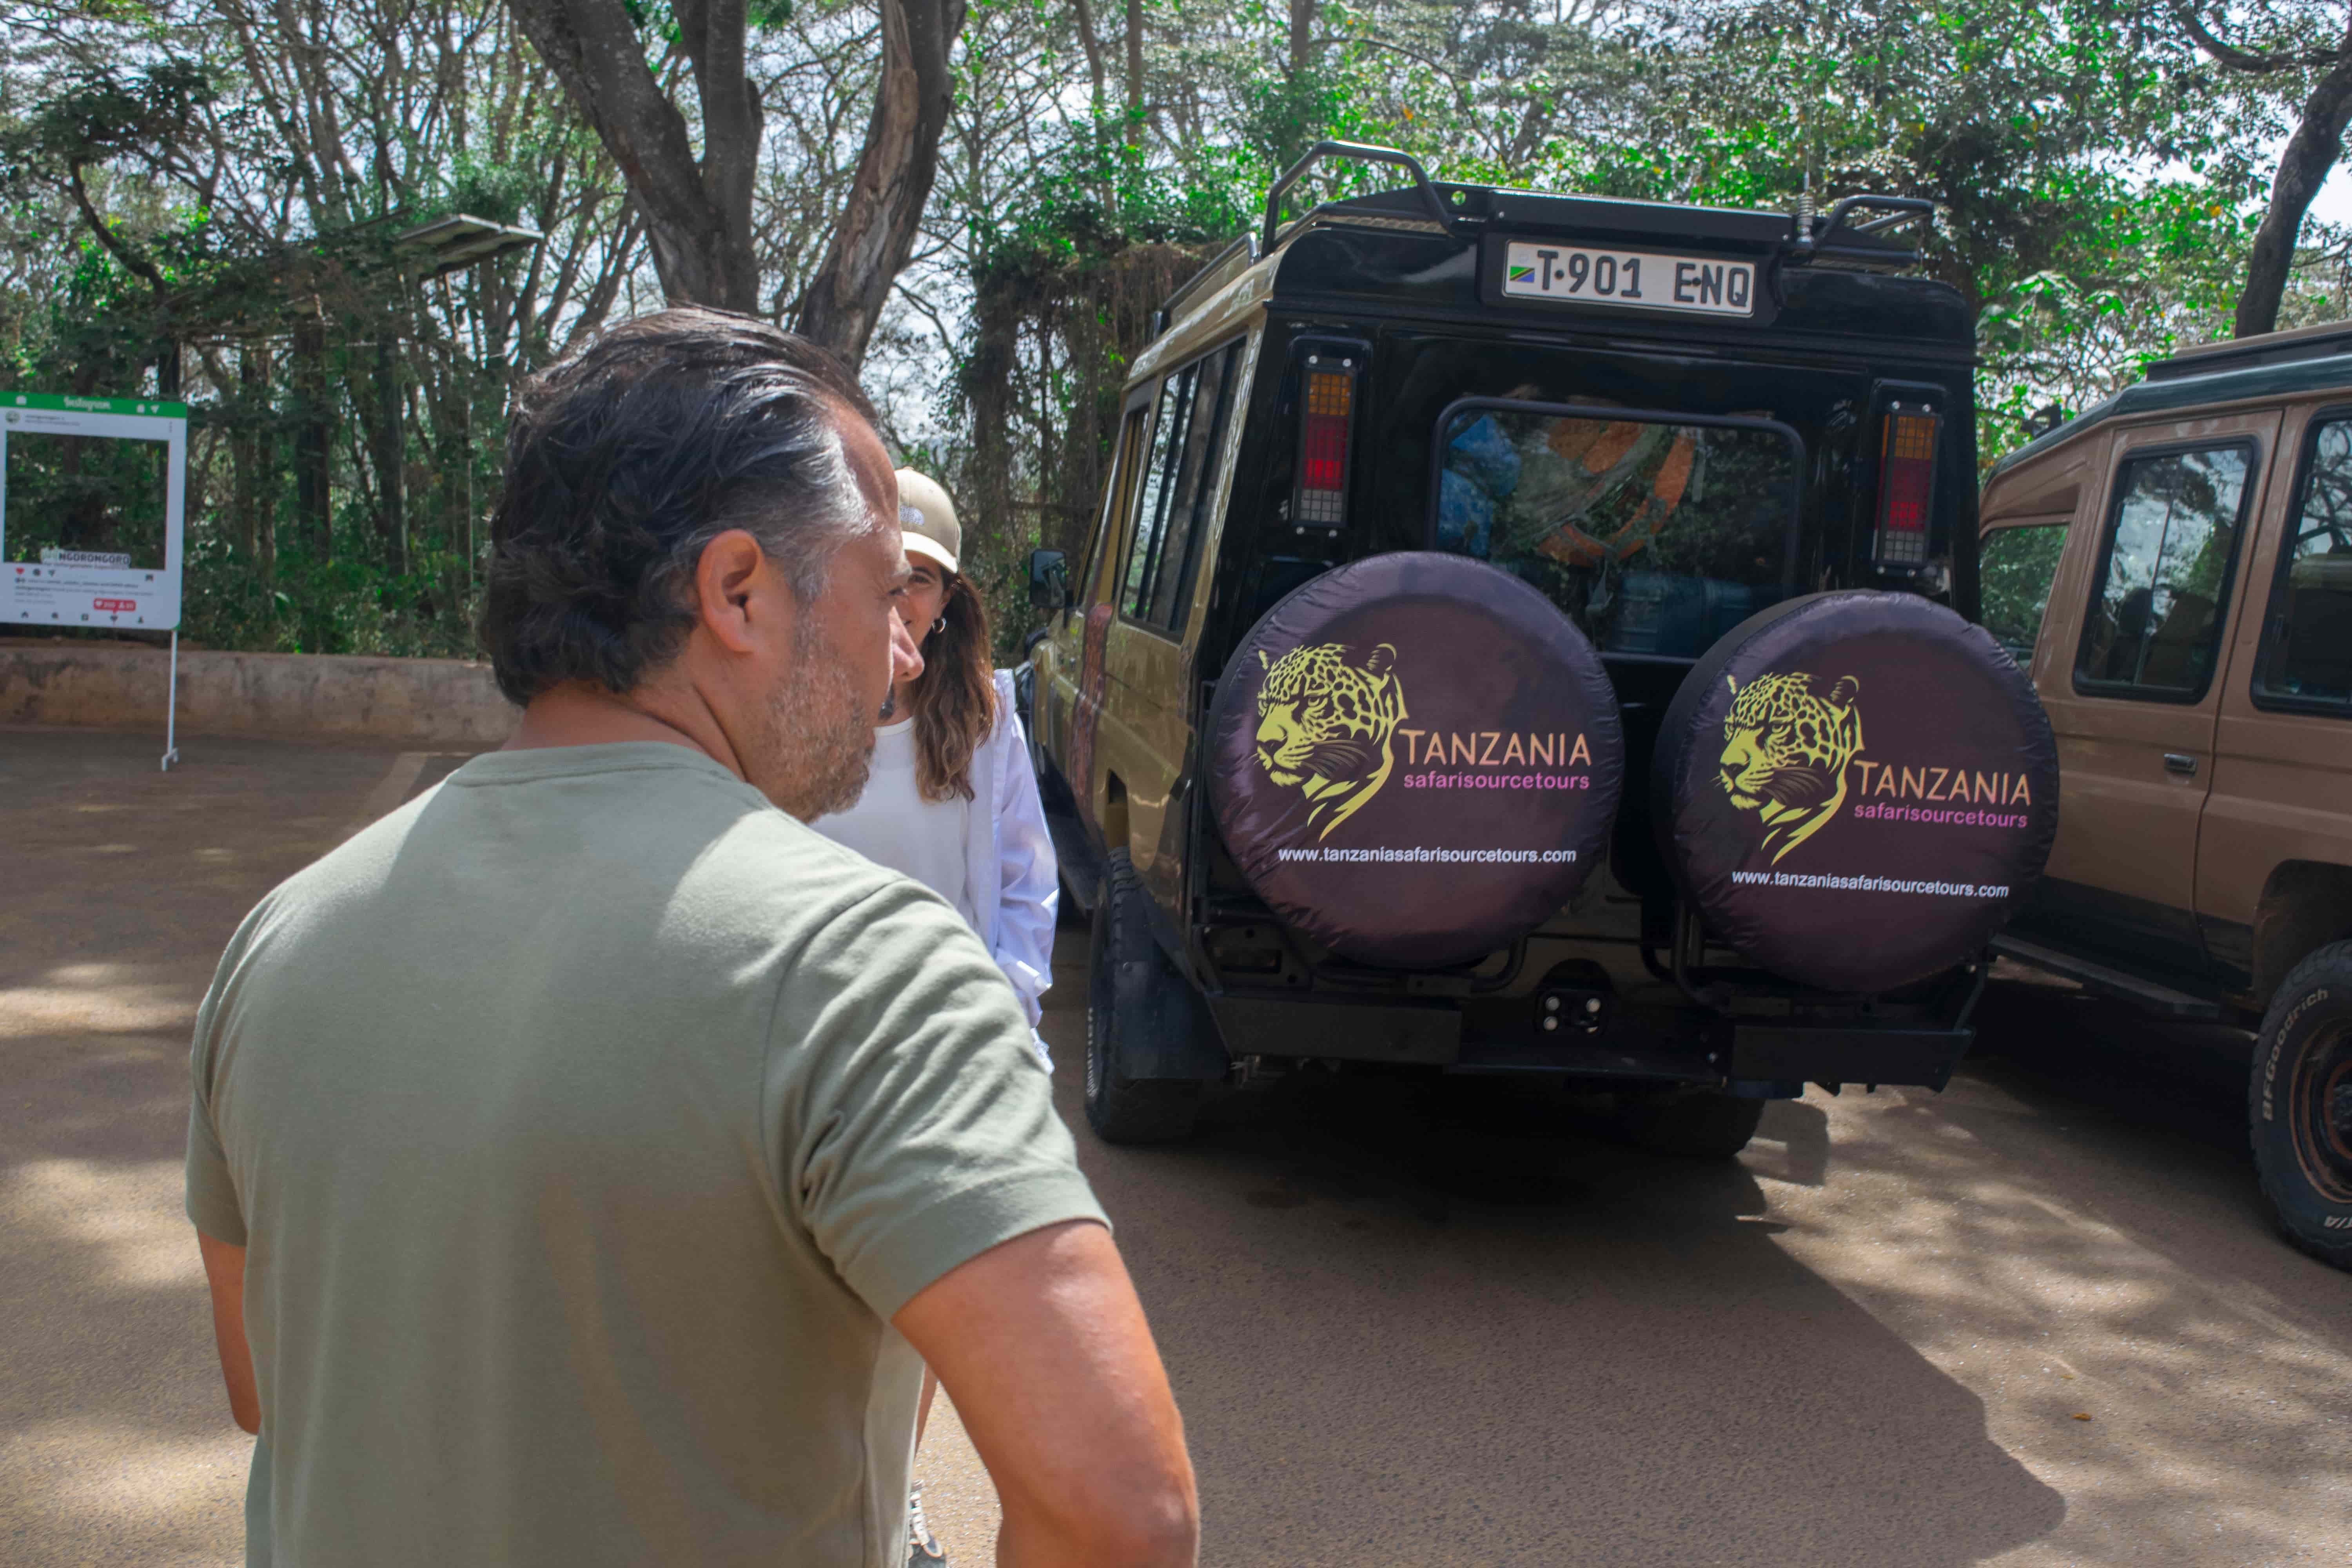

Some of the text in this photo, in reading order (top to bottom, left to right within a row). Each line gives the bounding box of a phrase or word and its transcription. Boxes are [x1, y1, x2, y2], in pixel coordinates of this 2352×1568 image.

[1674, 262, 1749, 307] ENQ
[59, 553, 130, 564] NGORONGORO
[1398, 728, 1592, 766] TANZANIA
[1403, 771, 1590, 789] safarisourcetours
[1854, 760, 2031, 806] TANZANIA
[1854, 802, 2028, 828] safarisourcetours
[1278, 846, 1577, 863] www.tanzaniasafarisourcetours.com
[1732, 870, 2009, 898] www.tanzaniasafarisourcetours.com
[2262, 989, 2328, 1120] BFGoodrich
